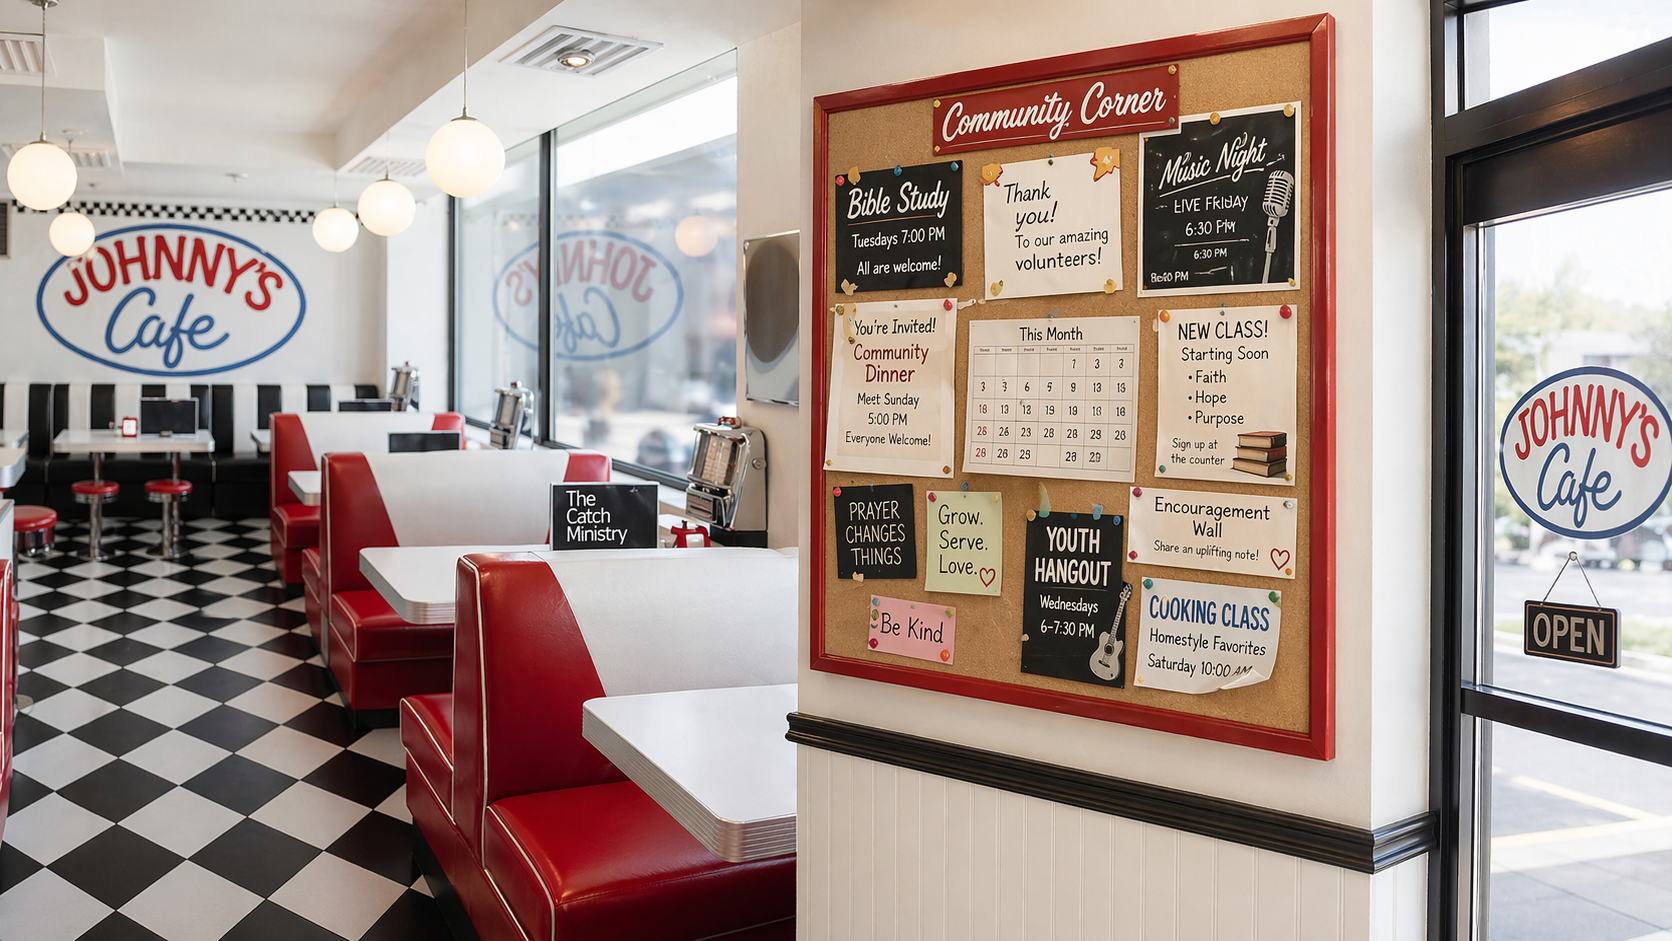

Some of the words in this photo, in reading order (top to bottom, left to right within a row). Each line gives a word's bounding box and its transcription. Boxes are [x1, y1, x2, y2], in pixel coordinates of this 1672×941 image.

[942, 92, 1072, 141] Community
[1081, 81, 1166, 124] Corner
[1159, 152, 1211, 190] Music
[1215, 132, 1268, 182] Night
[847, 187, 891, 219] Bible
[897, 180, 950, 218] Study
[1004, 180, 1050, 203] Thank
[1015, 201, 1058, 232] you!
[852, 232, 898, 250] Tuesdays
[901, 228, 925, 244] 7:00
[928, 226, 945, 241] PM
[1015, 235, 1030, 248] To
[1035, 236, 1054, 247] our
[1059, 228, 1108, 244] amazing
[1186, 221, 1212, 236] 6:30
[1015, 247, 1101, 271] volunteers!
[1193, 249, 1212, 259] 6:30
[1214, 248, 1227, 257] PM
[64, 234, 283, 311] JOHNNY'S
[856, 261, 870, 275] All
[873, 265, 890, 274] are
[893, 255, 941, 273] welcome!
[1175, 271, 1188, 282] PM
[105, 287, 230, 368] Cafe
[854, 319, 888, 336] You're
[892, 317, 936, 334] Invited!
[1020, 327, 1043, 341] This
[1046, 326, 1083, 341] Month
[1178, 322, 1211, 340] NEW
[1215, 320, 1268, 339] CLASS!
[854, 343, 929, 365] Community
[1181, 347, 1233, 364] Starting
[1238, 346, 1269, 360] Soon
[865, 364, 915, 382] Dinner
[1195, 370, 1227, 383] Faith
[1025, 382, 1030, 392] 6
[857, 393, 881, 405] Meet
[884, 393, 919, 409] Sunday
[1195, 390, 1227, 407] Hope
[868, 412, 889, 425] 5:00
[892, 413, 907, 425] PM
[1195, 410, 1244, 428] Purpose
[1515, 384, 1659, 468] JOHNNY'S
[846, 431, 886, 447] Everyone
[889, 433, 931, 446] Welcome!
[1172, 438, 1191, 451] Sign
[1195, 440, 1205, 451] up
[1208, 440, 1218, 449] at
[1171, 453, 1187, 464] the
[1189, 455, 1225, 465] counter
[1537, 442, 1622, 529] Cafe
[566, 490, 596, 507] The
[566, 507, 611, 524] Catch
[849, 500, 901, 521] PRAYER
[938, 504, 983, 525] Grow.
[1154, 497, 1270, 521] Encouragement
[566, 526, 628, 545] Ministry
[845, 524, 906, 544] CHANGES
[1193, 520, 1222, 538] Wall
[939, 530, 988, 550] Serve.
[1046, 526, 1100, 554] YOUTH
[851, 547, 902, 566] THINGS
[1154, 540, 1179, 553] Share
[1182, 544, 1193, 554] an
[1196, 545, 1232, 562] uplifting
[1235, 549, 1259, 561] note!
[939, 554, 978, 575] Love.
[1035, 557, 1112, 587] HANGOUT
[1040, 594, 1099, 617] Wednesdays
[880, 612, 900, 636] Be
[908, 616, 944, 643] Kind
[1221, 603, 1270, 632] CLASS
[1079, 622, 1095, 638] PM
[1533, 612, 1605, 656] OPEN
[1150, 628, 1209, 652] Homestyle
[1213, 635, 1266, 656] Favorites
[1148, 653, 1196, 678] Saturday
[1201, 661, 1231, 677] 10:00
[1231, 665, 1253, 676] AM
